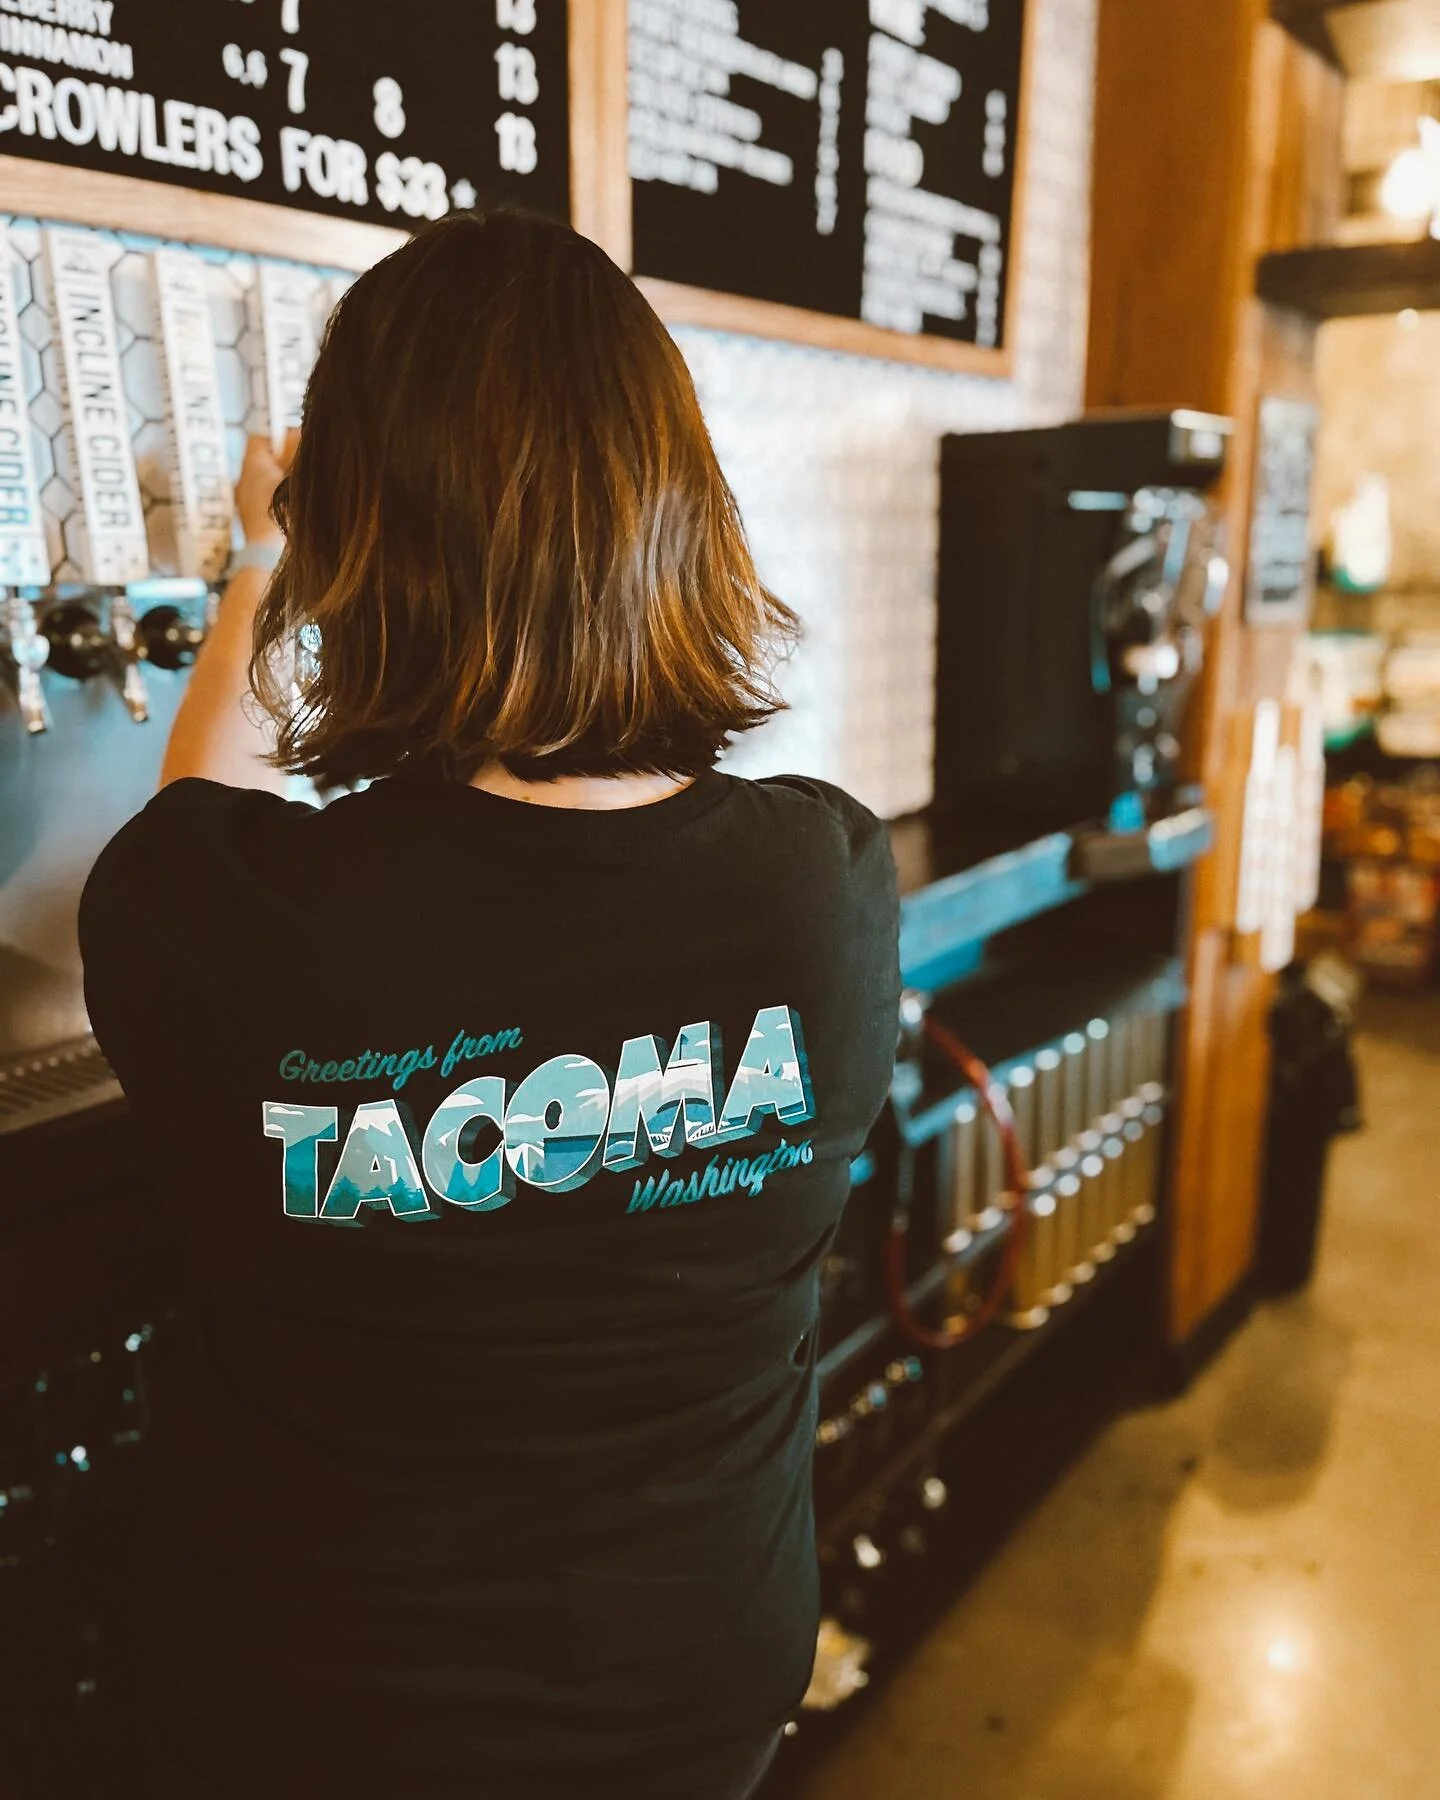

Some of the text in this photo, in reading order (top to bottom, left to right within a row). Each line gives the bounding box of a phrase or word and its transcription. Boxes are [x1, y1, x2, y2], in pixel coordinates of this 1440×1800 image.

[280, 48, 309, 114] 7
[373, 76, 406, 138] 8
[280, 126, 368, 205] FOR
[68, 289, 132, 529] INCLINE CIDER
[279, 1026, 523, 1091] Greetings from
[262, 1005, 815, 1228] TACOMA
[625, 1138, 813, 1214] Washington
